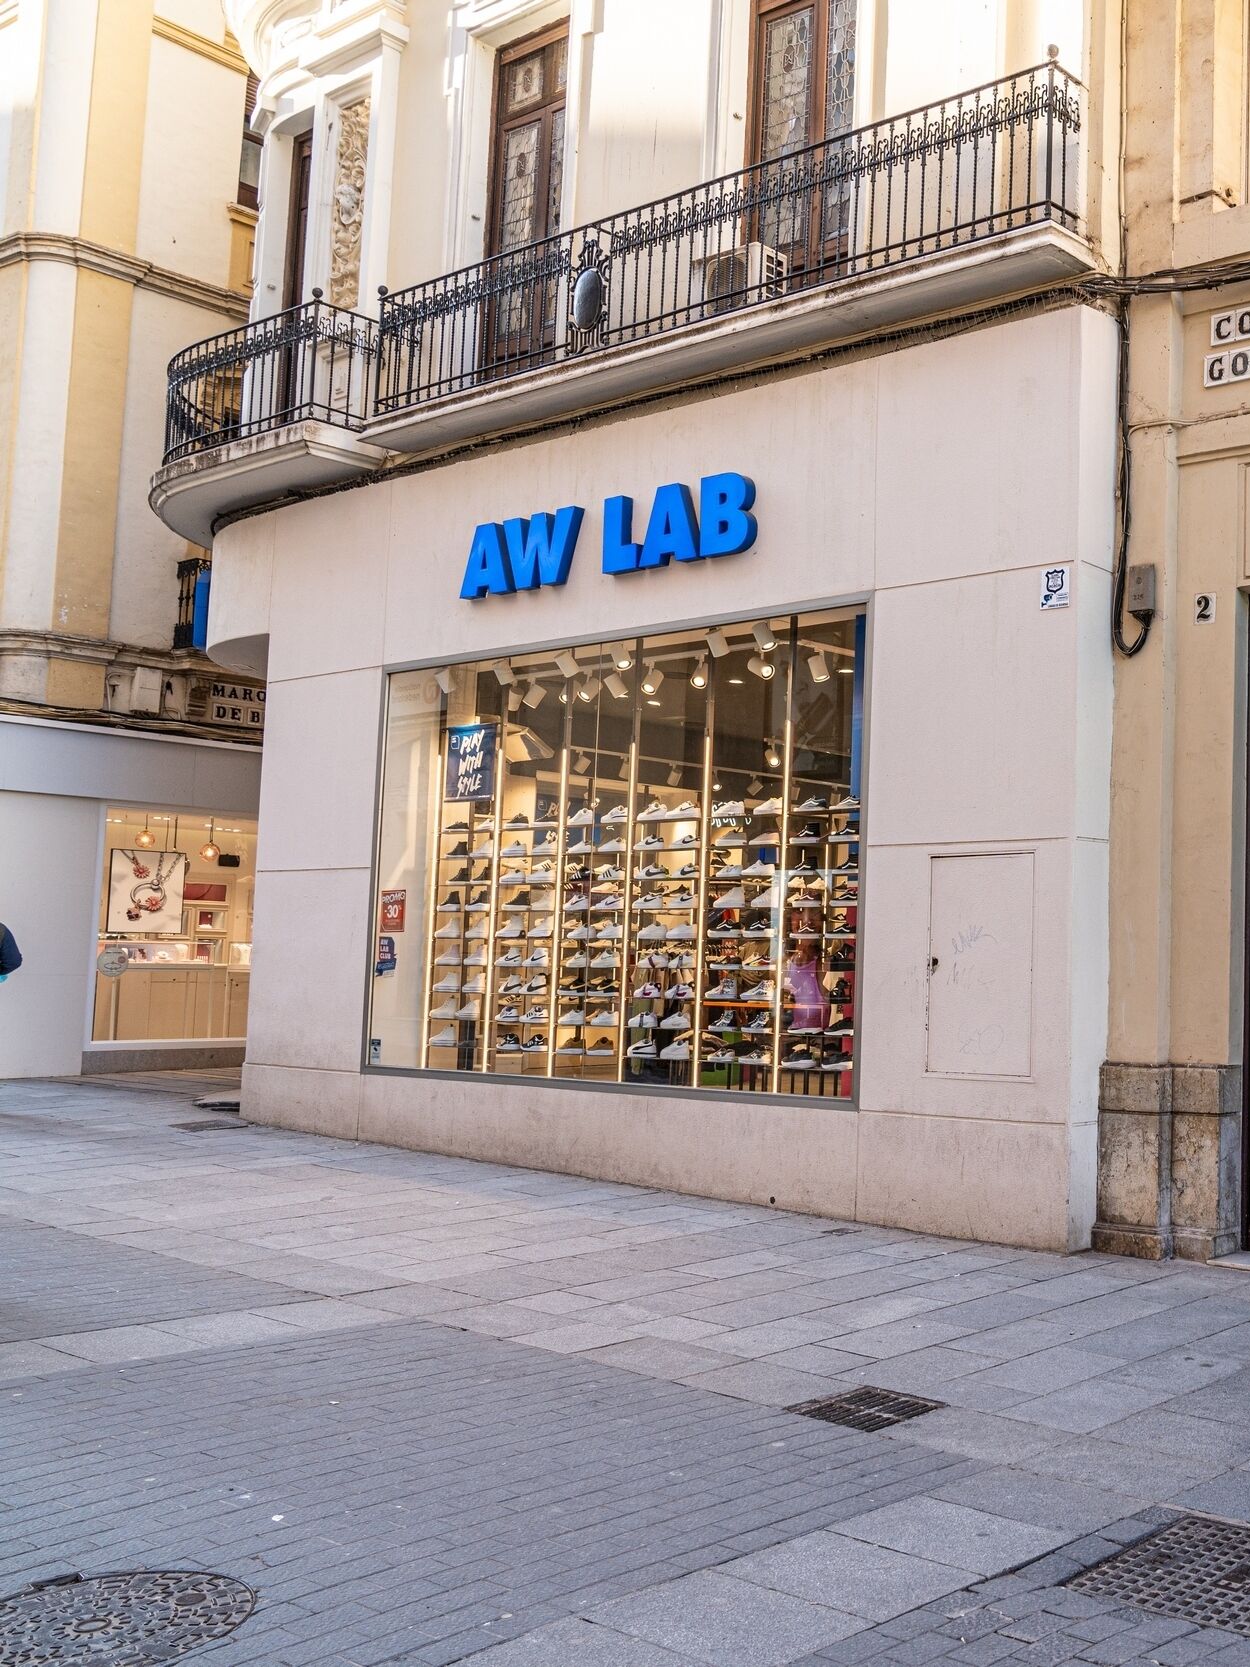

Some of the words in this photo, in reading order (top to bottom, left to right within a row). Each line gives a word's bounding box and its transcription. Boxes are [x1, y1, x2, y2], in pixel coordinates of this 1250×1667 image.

[460, 505, 585, 600] AW
[602, 472, 758, 575] LAB
[1196, 595, 1211, 622] 2
[215, 706, 241, 721] DE
[460, 729, 485, 755] PLAY
[458, 751, 483, 776] WITH
[457, 774, 482, 799] STYLE
